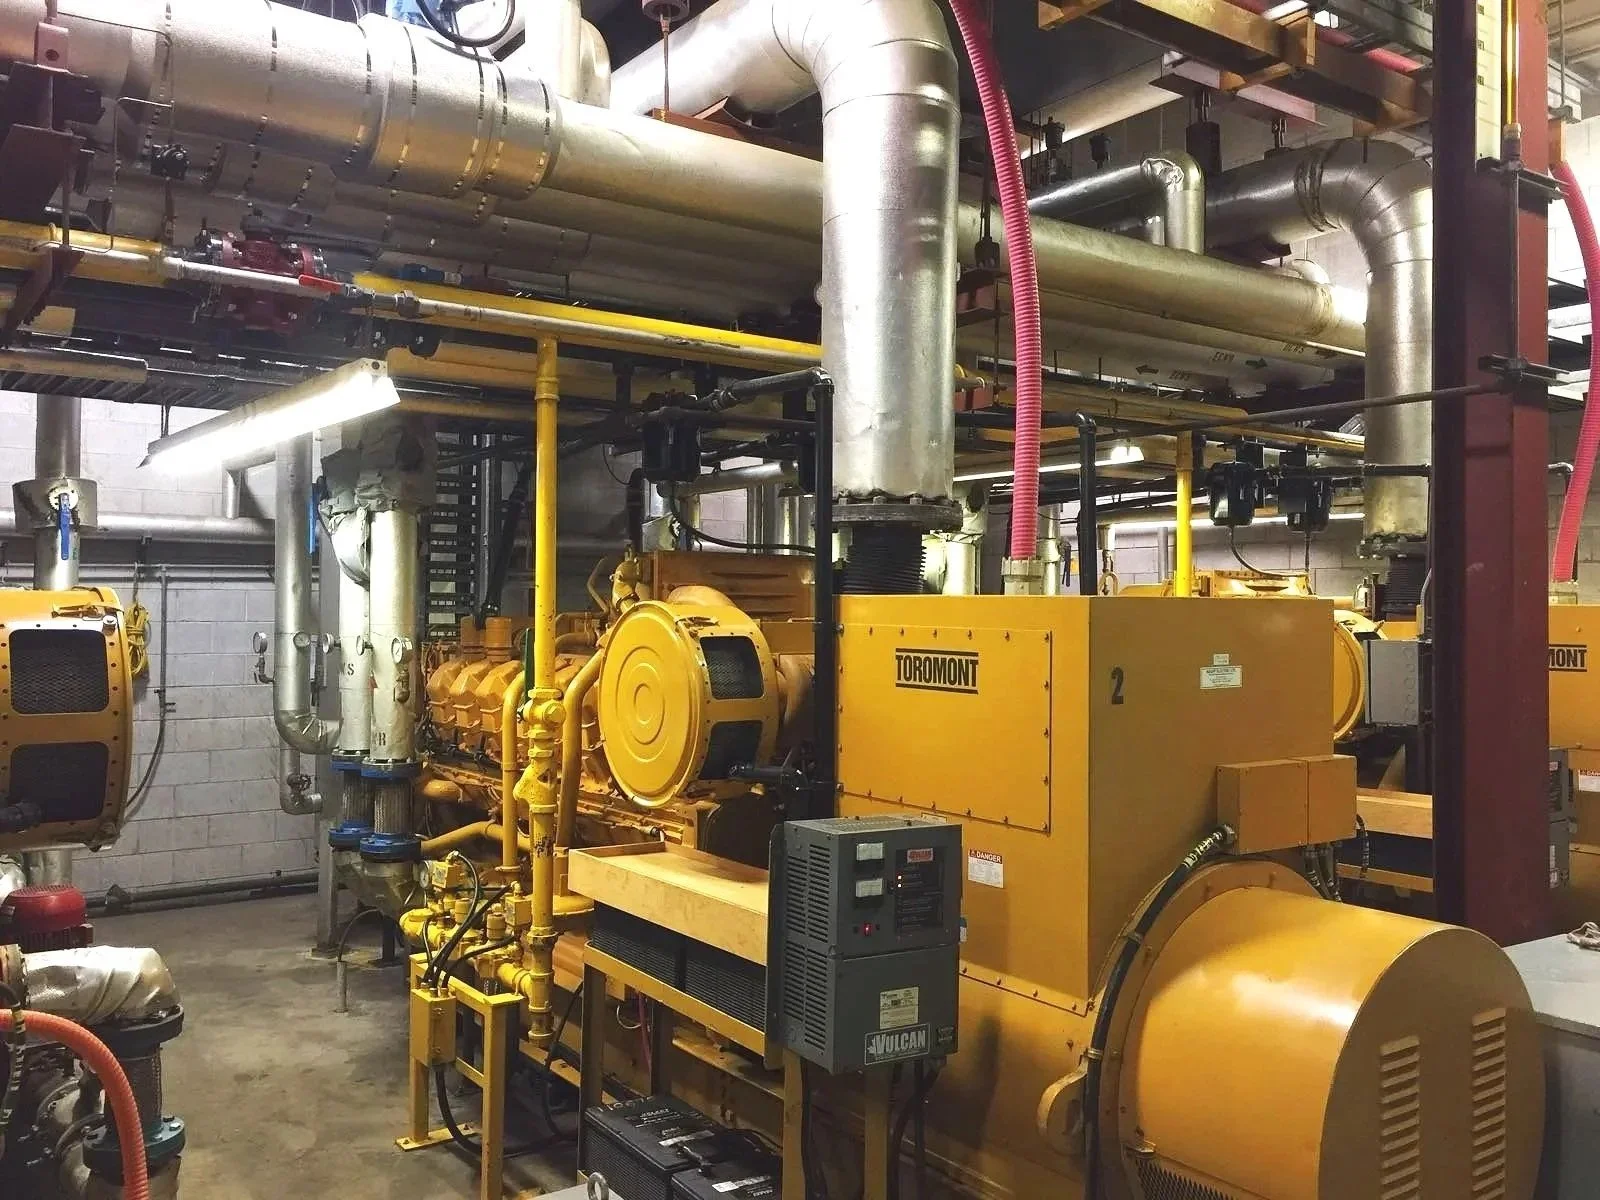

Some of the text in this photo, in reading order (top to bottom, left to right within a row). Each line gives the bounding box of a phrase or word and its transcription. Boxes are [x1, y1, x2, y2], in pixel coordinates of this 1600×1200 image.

[895, 654, 979, 687] TOROMONT
[1111, 666, 1124, 705] 2
[976, 851, 1002, 864] DANGER
[874, 1030, 926, 1054] VULCAN
